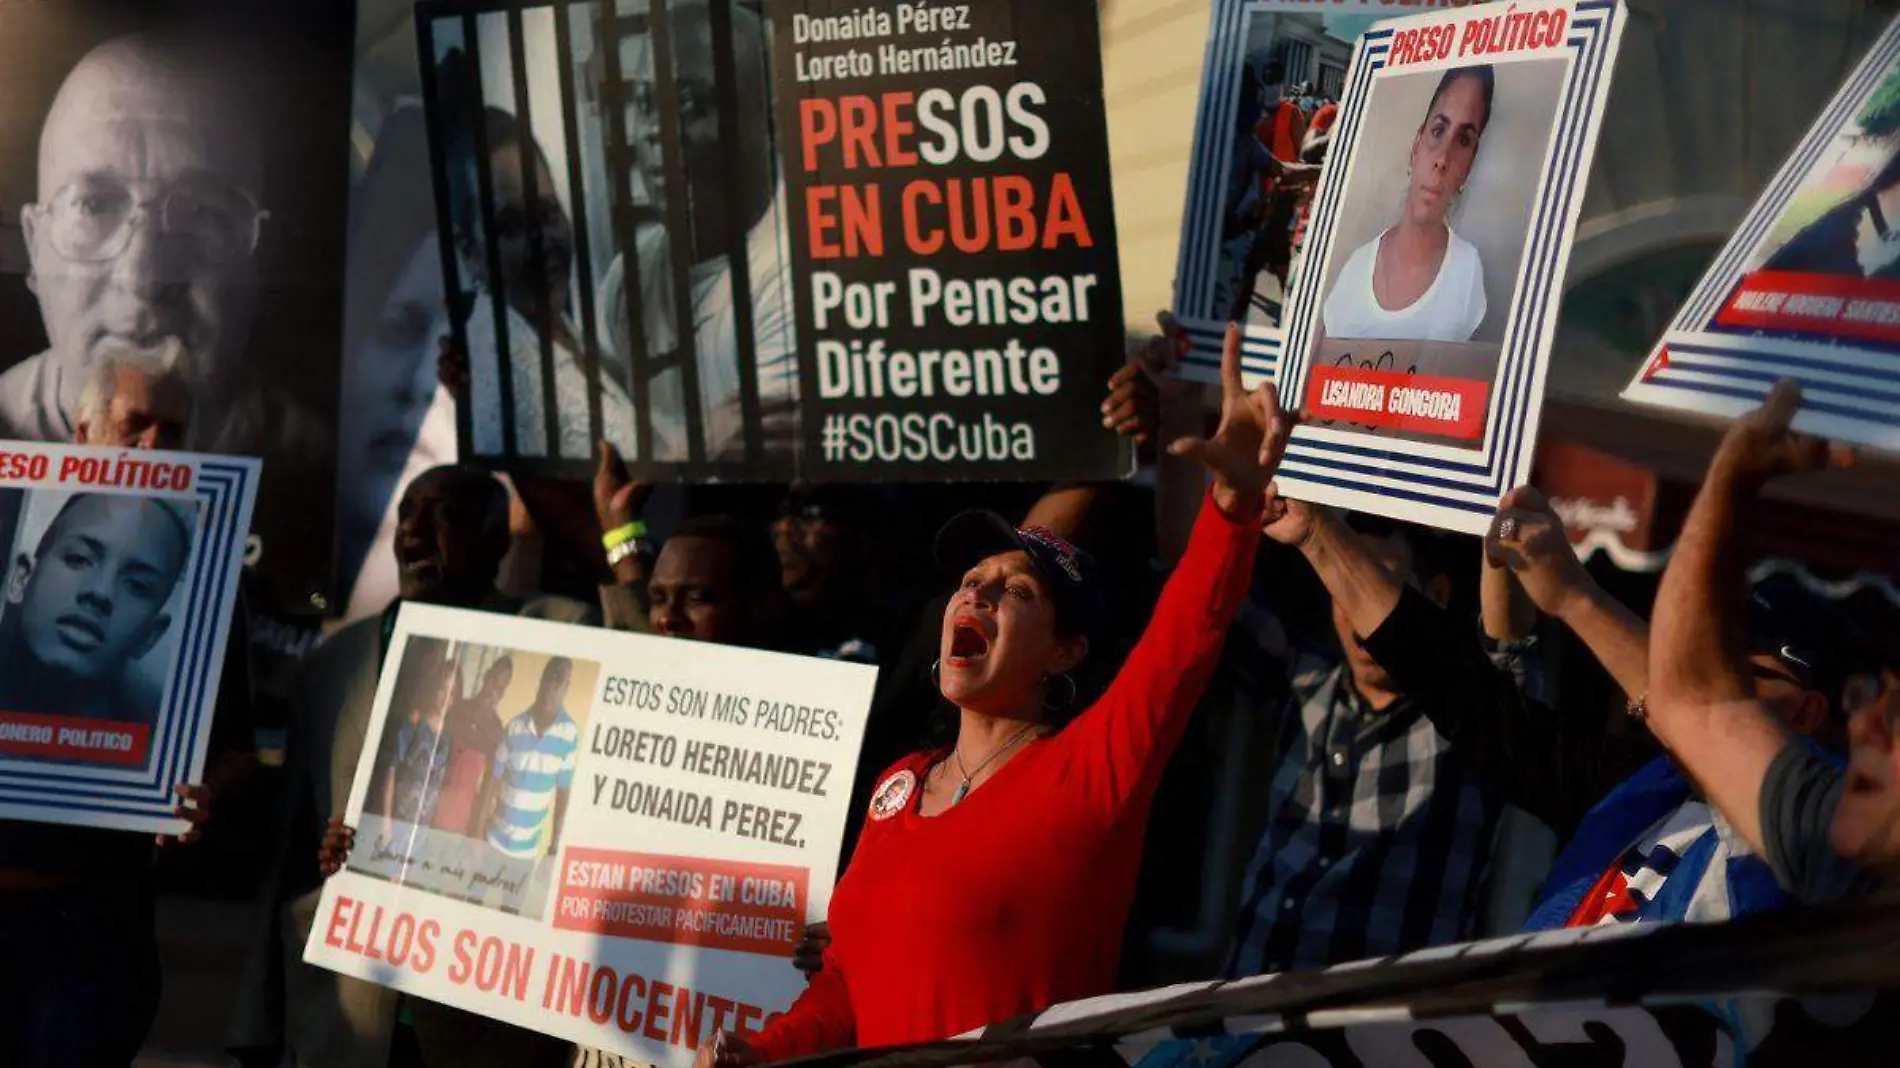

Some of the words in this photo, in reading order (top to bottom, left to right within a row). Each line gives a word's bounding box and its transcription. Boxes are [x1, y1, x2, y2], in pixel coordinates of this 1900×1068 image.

[793, 13, 891, 43] Donaida
[897, 1, 970, 35] Pérez
[1388, 23, 1456, 66] PRESO
[1458, 3, 1567, 57] POLÍTICO
[796, 51, 873, 81] Loreto
[879, 37, 1017, 74] Hernández
[800, 82, 1050, 172] PRESOS
[806, 183, 884, 259] EN
[901, 172, 1094, 255] CUBA
[811, 270, 896, 330] Por
[908, 268, 1097, 327] Pensar
[816, 338, 1061, 399] Diferente
[1321, 379, 1385, 412] LISANDRA
[1388, 387, 1462, 421] GONGORA
[821, 412, 1036, 463] #SOSCuba
[59, 452, 192, 492] POLÍTICO
[603, 676, 663, 711] ESTOS
[667, 686, 708, 719] SON
[711, 693, 751, 725] MIS
[754, 699, 844, 741] PADRES:
[58, 727, 132, 752] POLITICO
[591, 723, 677, 768] LORETO
[681, 739, 832, 797] HERNANDEZ
[592, 774, 607, 805] Y
[610, 779, 712, 829] DONAIDA
[720, 800, 806, 848] PEREZ.
[566, 859, 625, 890] ESTAN
[628, 865, 704, 899] PRESOS
[708, 873, 735, 903] EN
[740, 876, 797, 909] CUBA
[560, 896, 590, 918] POR
[592, 899, 673, 929] PROTESTAR
[675, 908, 795, 942] PACIFICAMENTE
[324, 895, 441, 974] ELLOS
[448, 929, 535, 1002] SON
[542, 951, 784, 1051] INOCENTE
